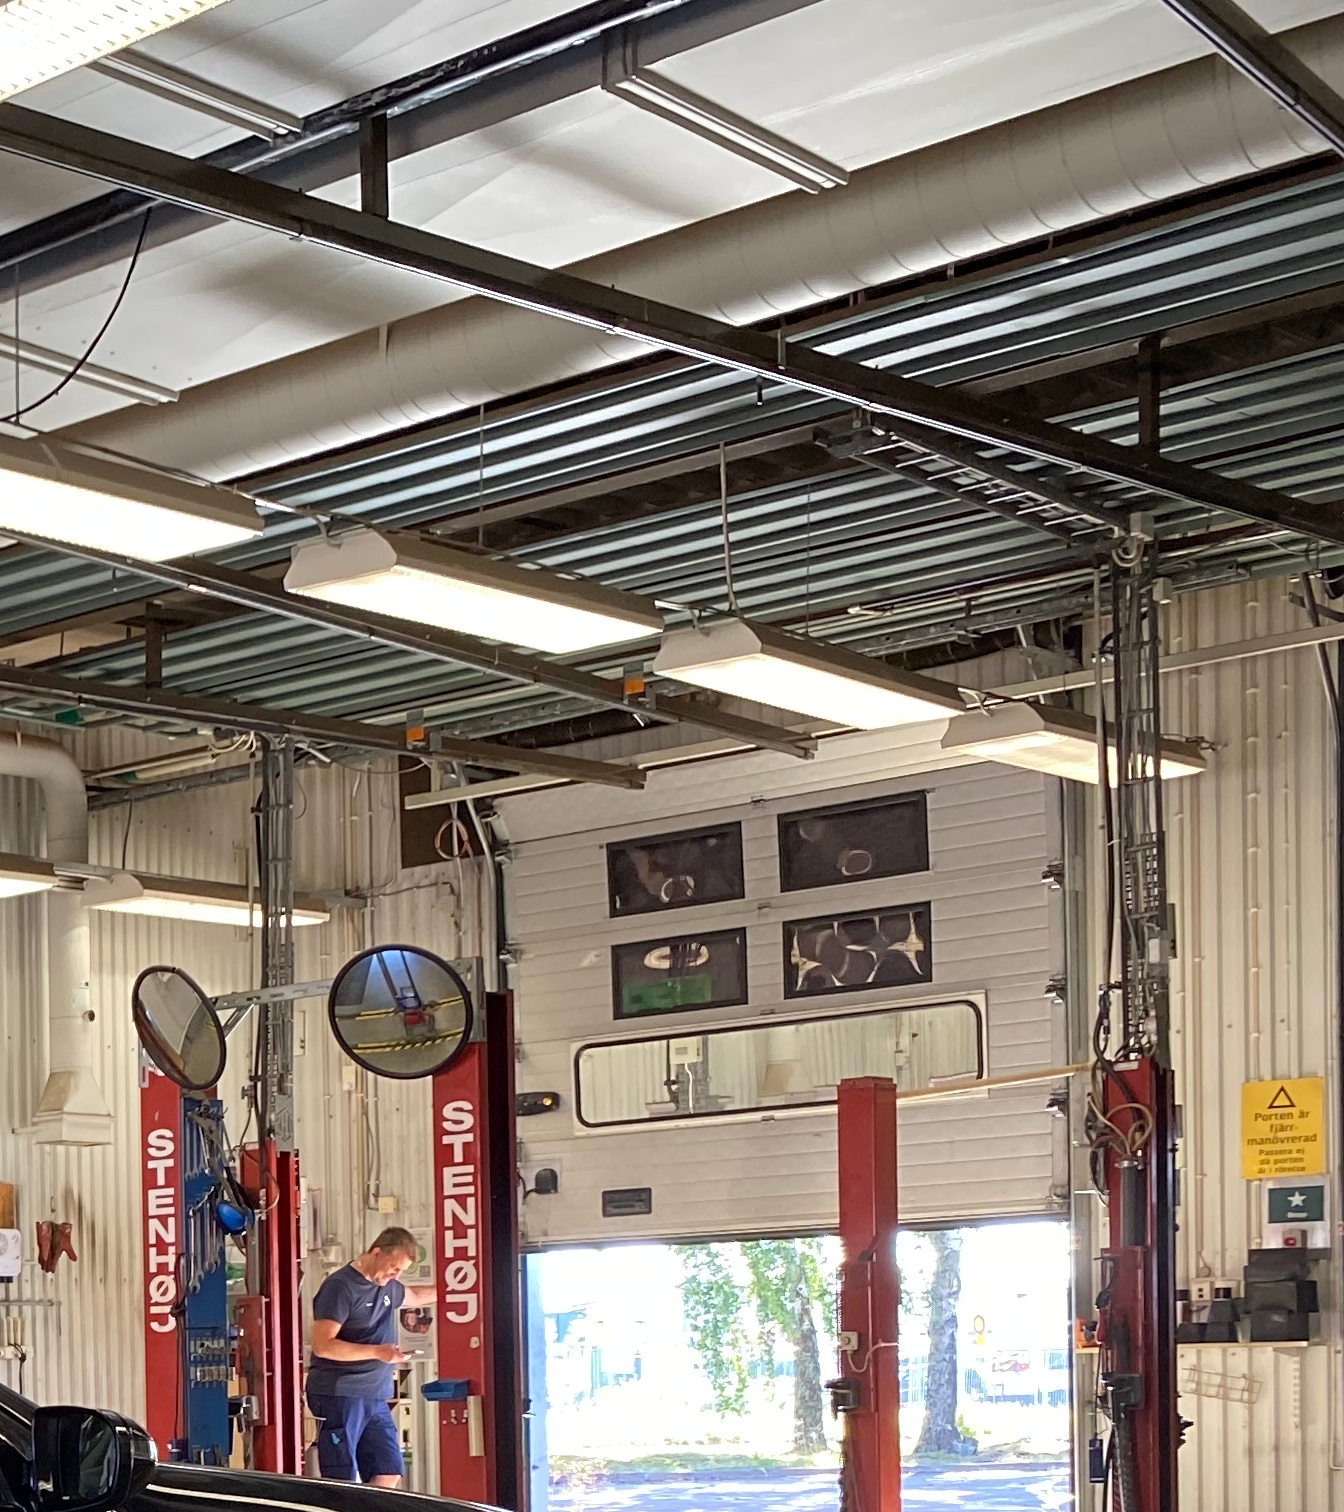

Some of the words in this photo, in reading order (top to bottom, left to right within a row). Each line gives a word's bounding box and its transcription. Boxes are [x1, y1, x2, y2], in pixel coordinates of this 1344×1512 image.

[1254, 1111, 1294, 1122] Porten
[1298, 1109, 1311, 1119] är
[1269, 1122, 1299, 1135] fjärr-
[1247, 1133, 1317, 1146] manövrerad
[1258, 1148, 1292, 1156] Passera
[1296, 1147, 1305, 1156] ej
[1273, 1157, 1304, 1166] porten
[441, 1100, 478, 1324] STENHØJ
[147, 1128, 177, 1333] STENHØJ
